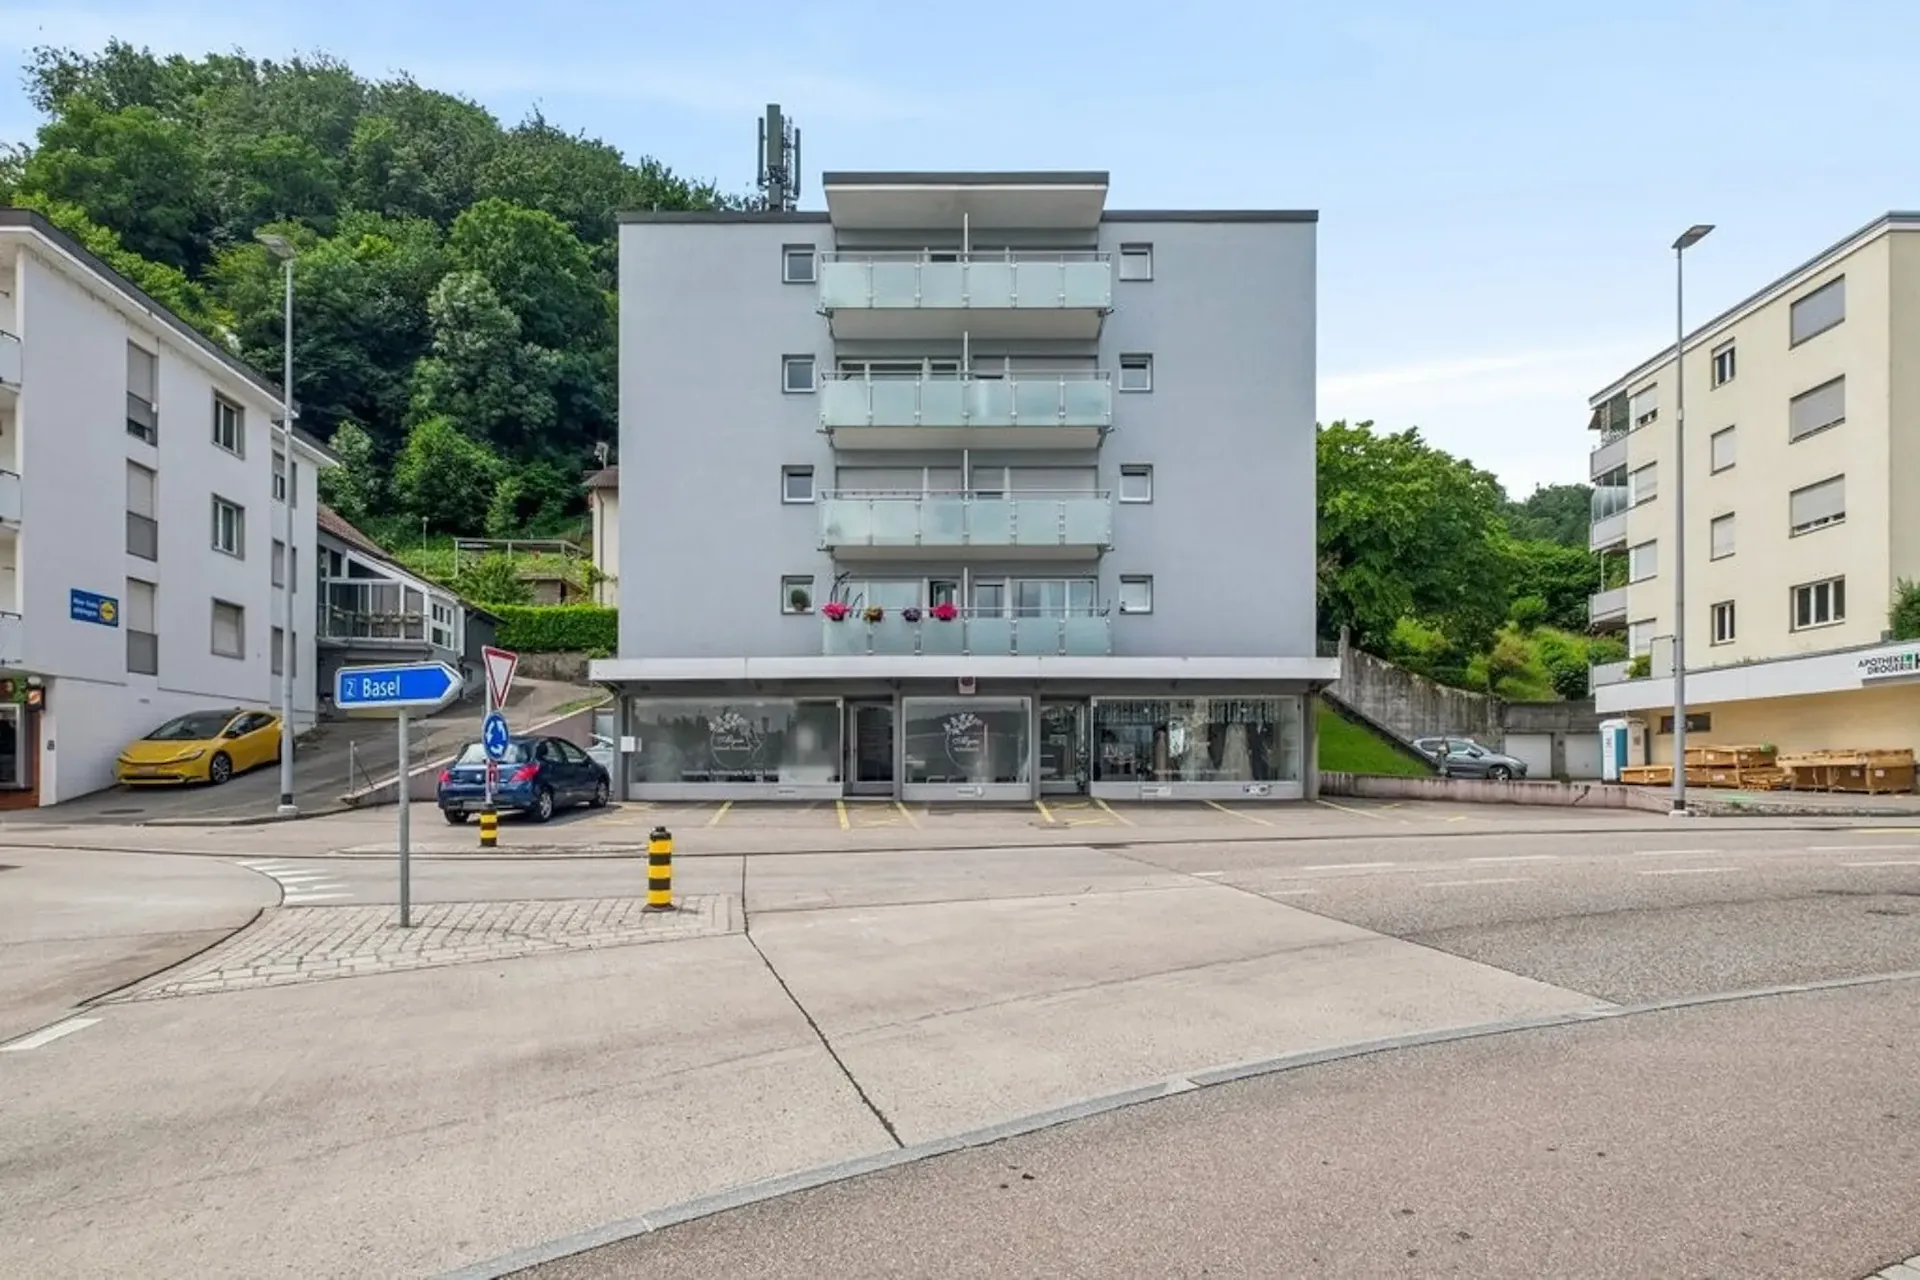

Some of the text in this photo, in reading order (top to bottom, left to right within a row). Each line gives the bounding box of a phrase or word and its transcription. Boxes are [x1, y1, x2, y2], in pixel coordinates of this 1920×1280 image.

[1867, 663, 1912, 675] DROGERIE
[346, 675, 400, 698] 2 Basel
